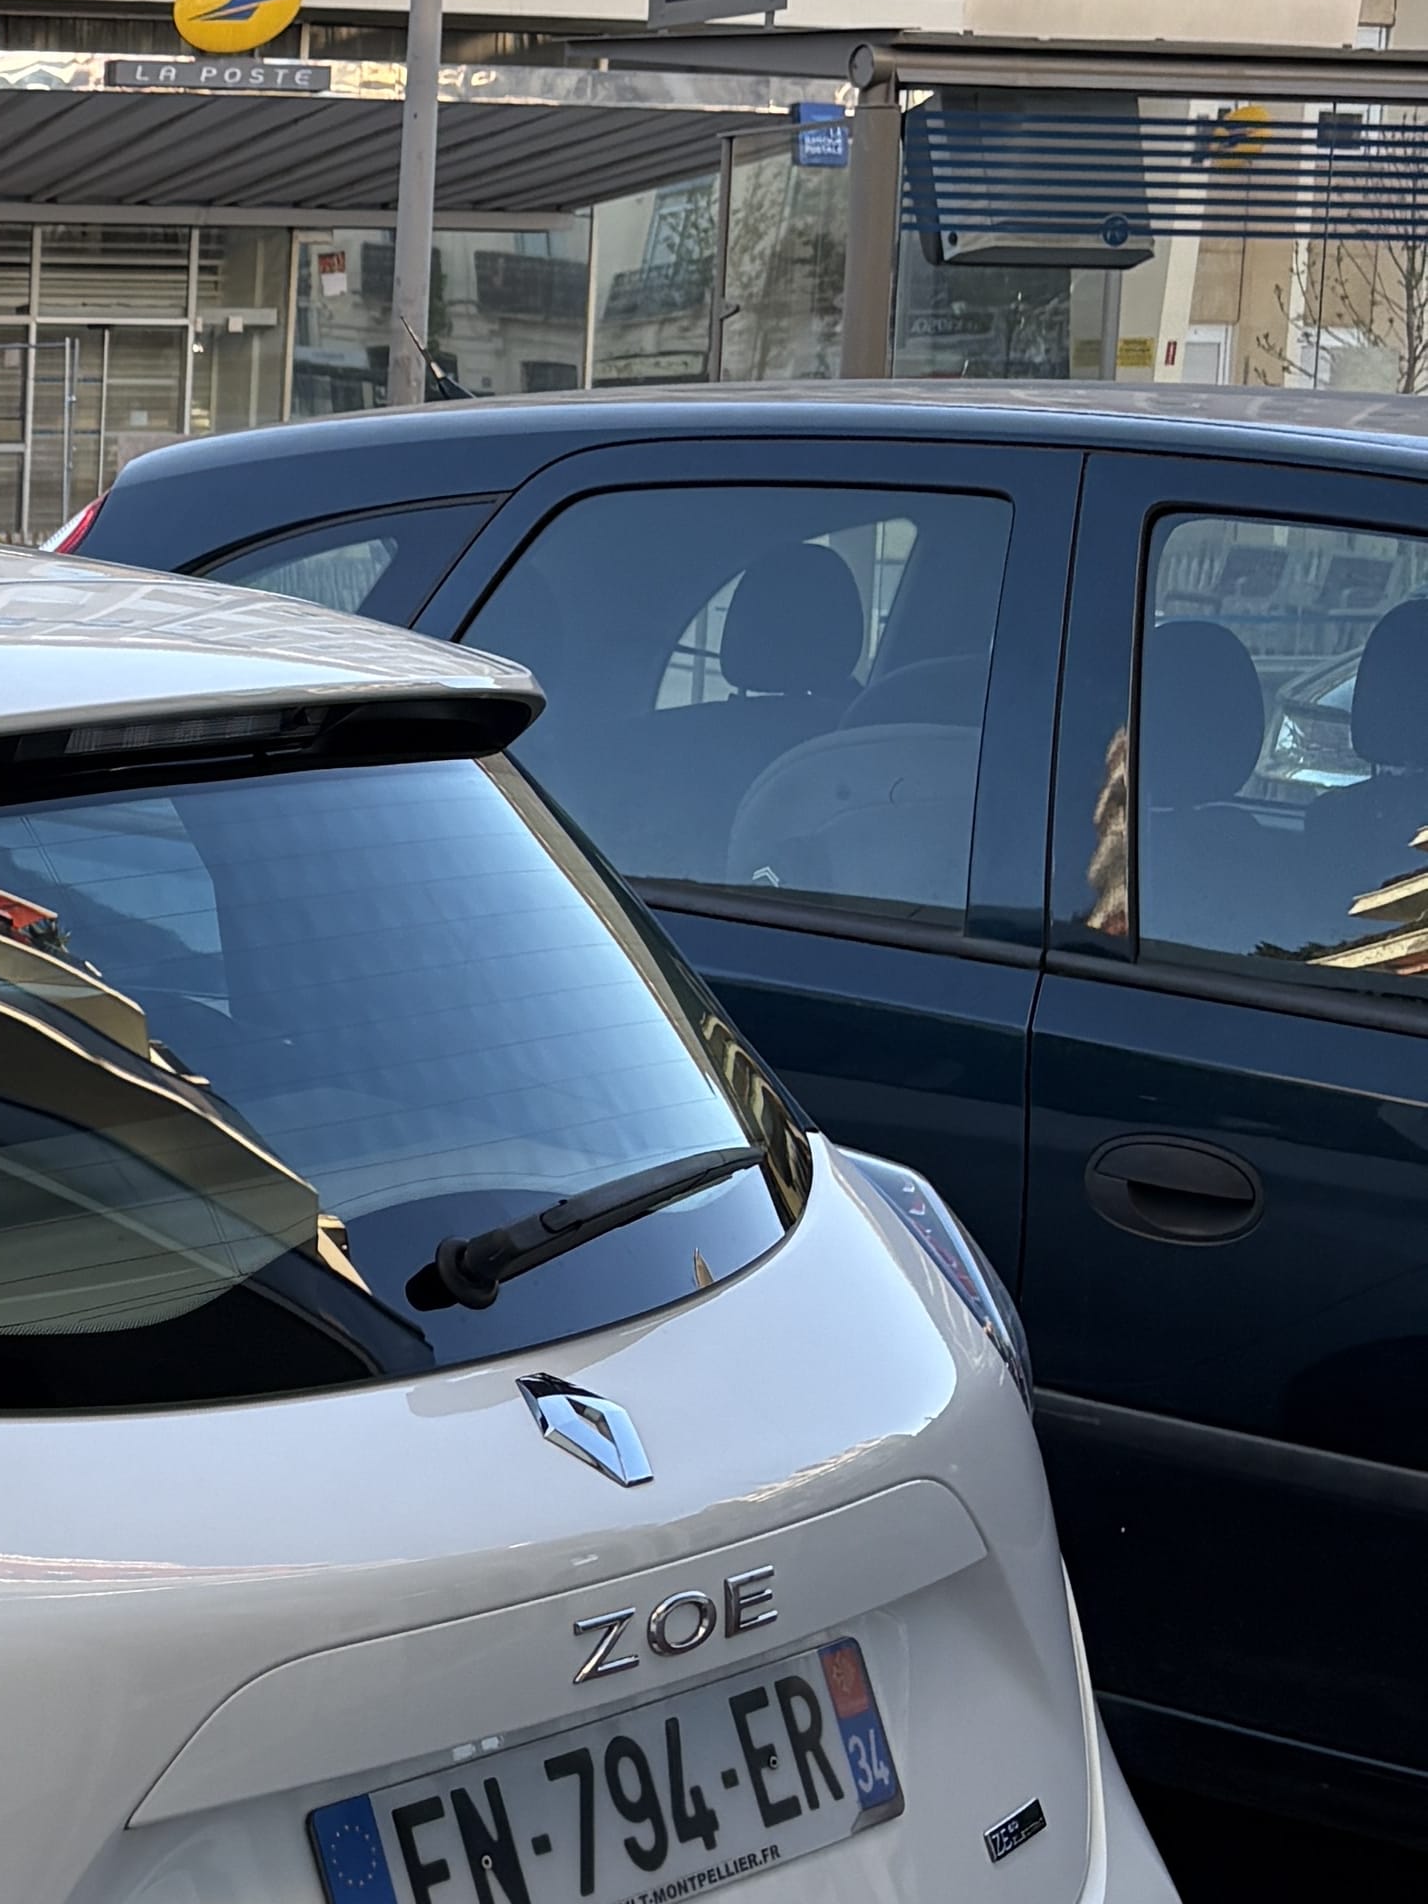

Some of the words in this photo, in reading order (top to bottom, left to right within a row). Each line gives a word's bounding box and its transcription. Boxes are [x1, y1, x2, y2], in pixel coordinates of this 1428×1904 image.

[135, 65, 177, 82] LA
[200, 67, 313, 86] POSTE
[573, 1564, 779, 1684] ZOE
[848, 1728, 890, 1793] 34
